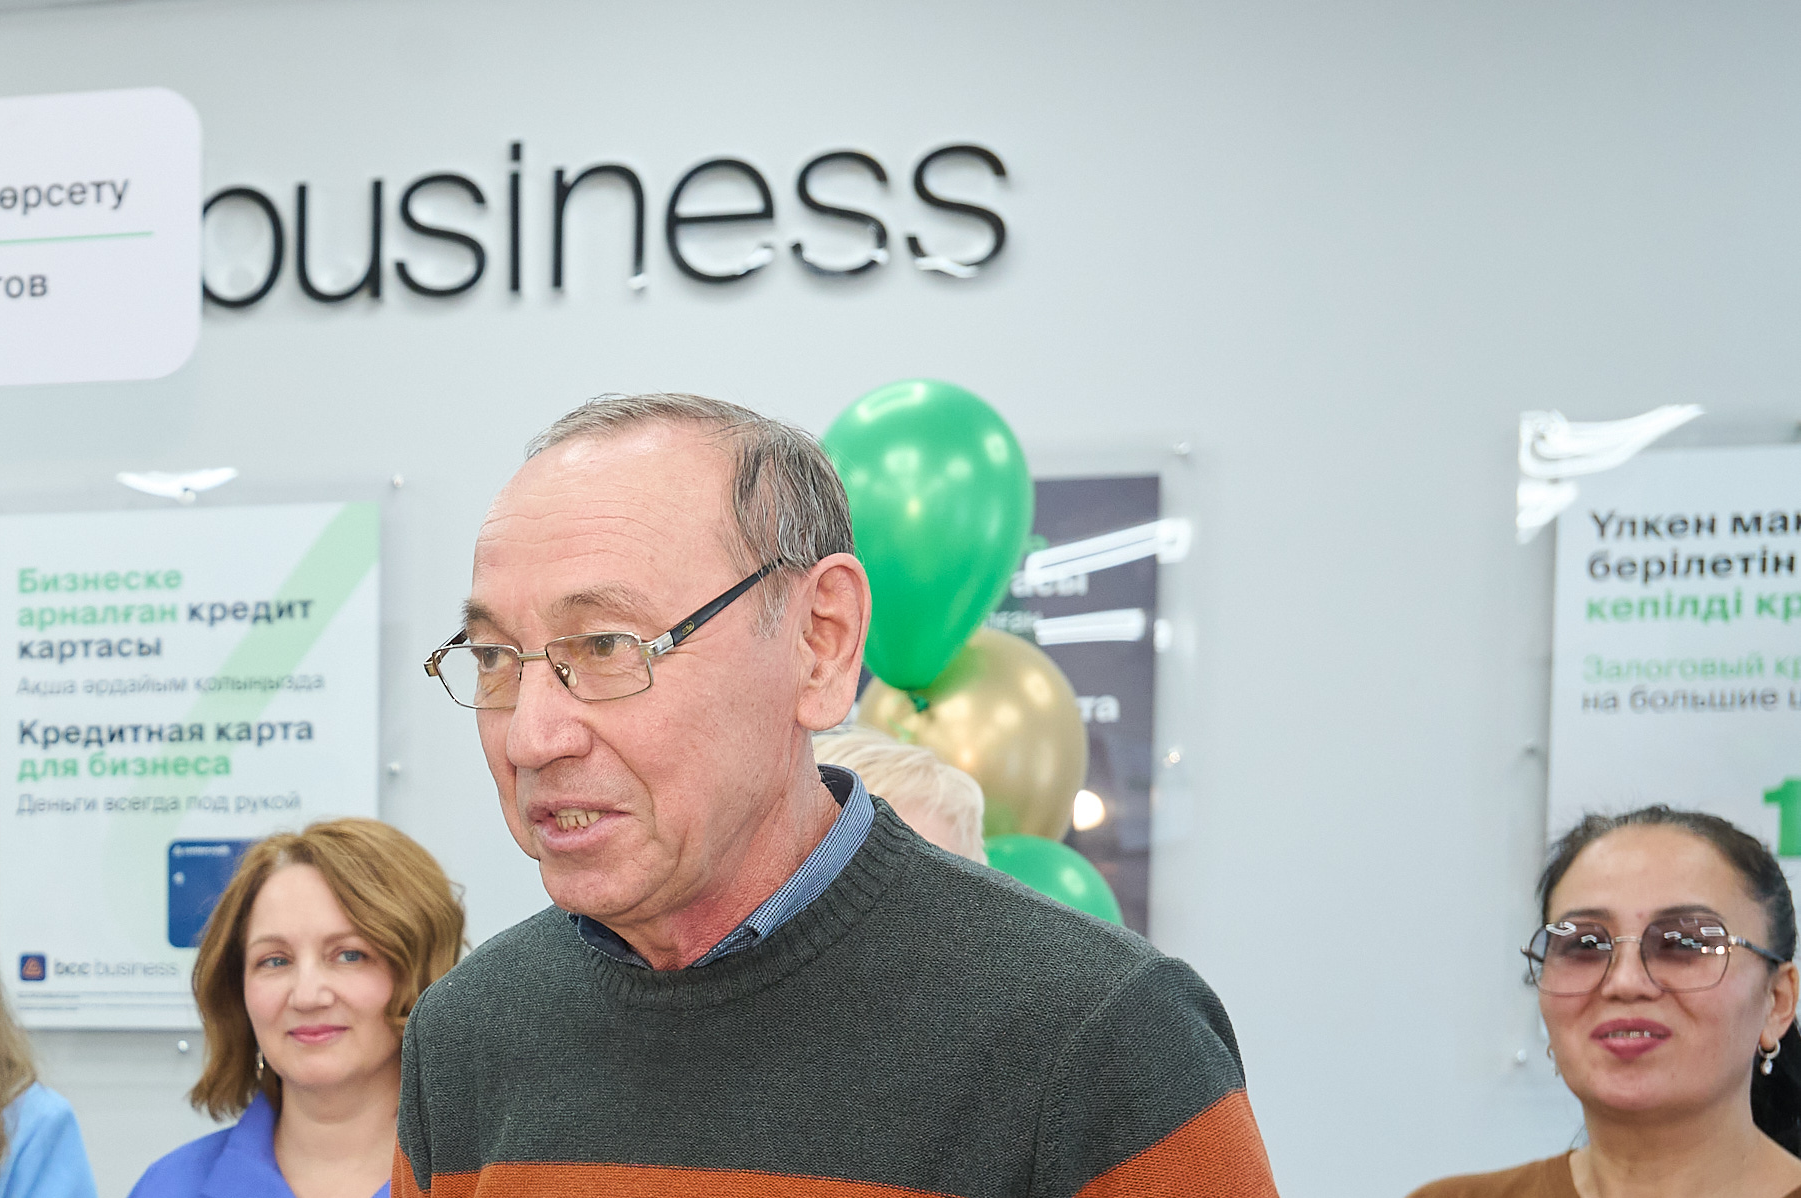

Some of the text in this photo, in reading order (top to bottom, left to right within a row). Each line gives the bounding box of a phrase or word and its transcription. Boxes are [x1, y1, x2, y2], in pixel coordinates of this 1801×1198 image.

[1731, 509, 1801, 536] ма
[1588, 545, 1795, 584] берілетін
[17, 568, 184, 594] Бизнеске
[17, 599, 314, 632] арналған кредит
[1586, 587, 1743, 625] кепілді
[17, 637, 163, 664] картасы
[1583, 652, 1765, 684] Залоговый
[1582, 691, 1619, 713] на
[1629, 685, 1778, 714] большие
[17, 718, 316, 749] Кредитная карта
[16, 750, 233, 783] для бизнеса
[16, 791, 303, 816] Деньги всегда под рукой
